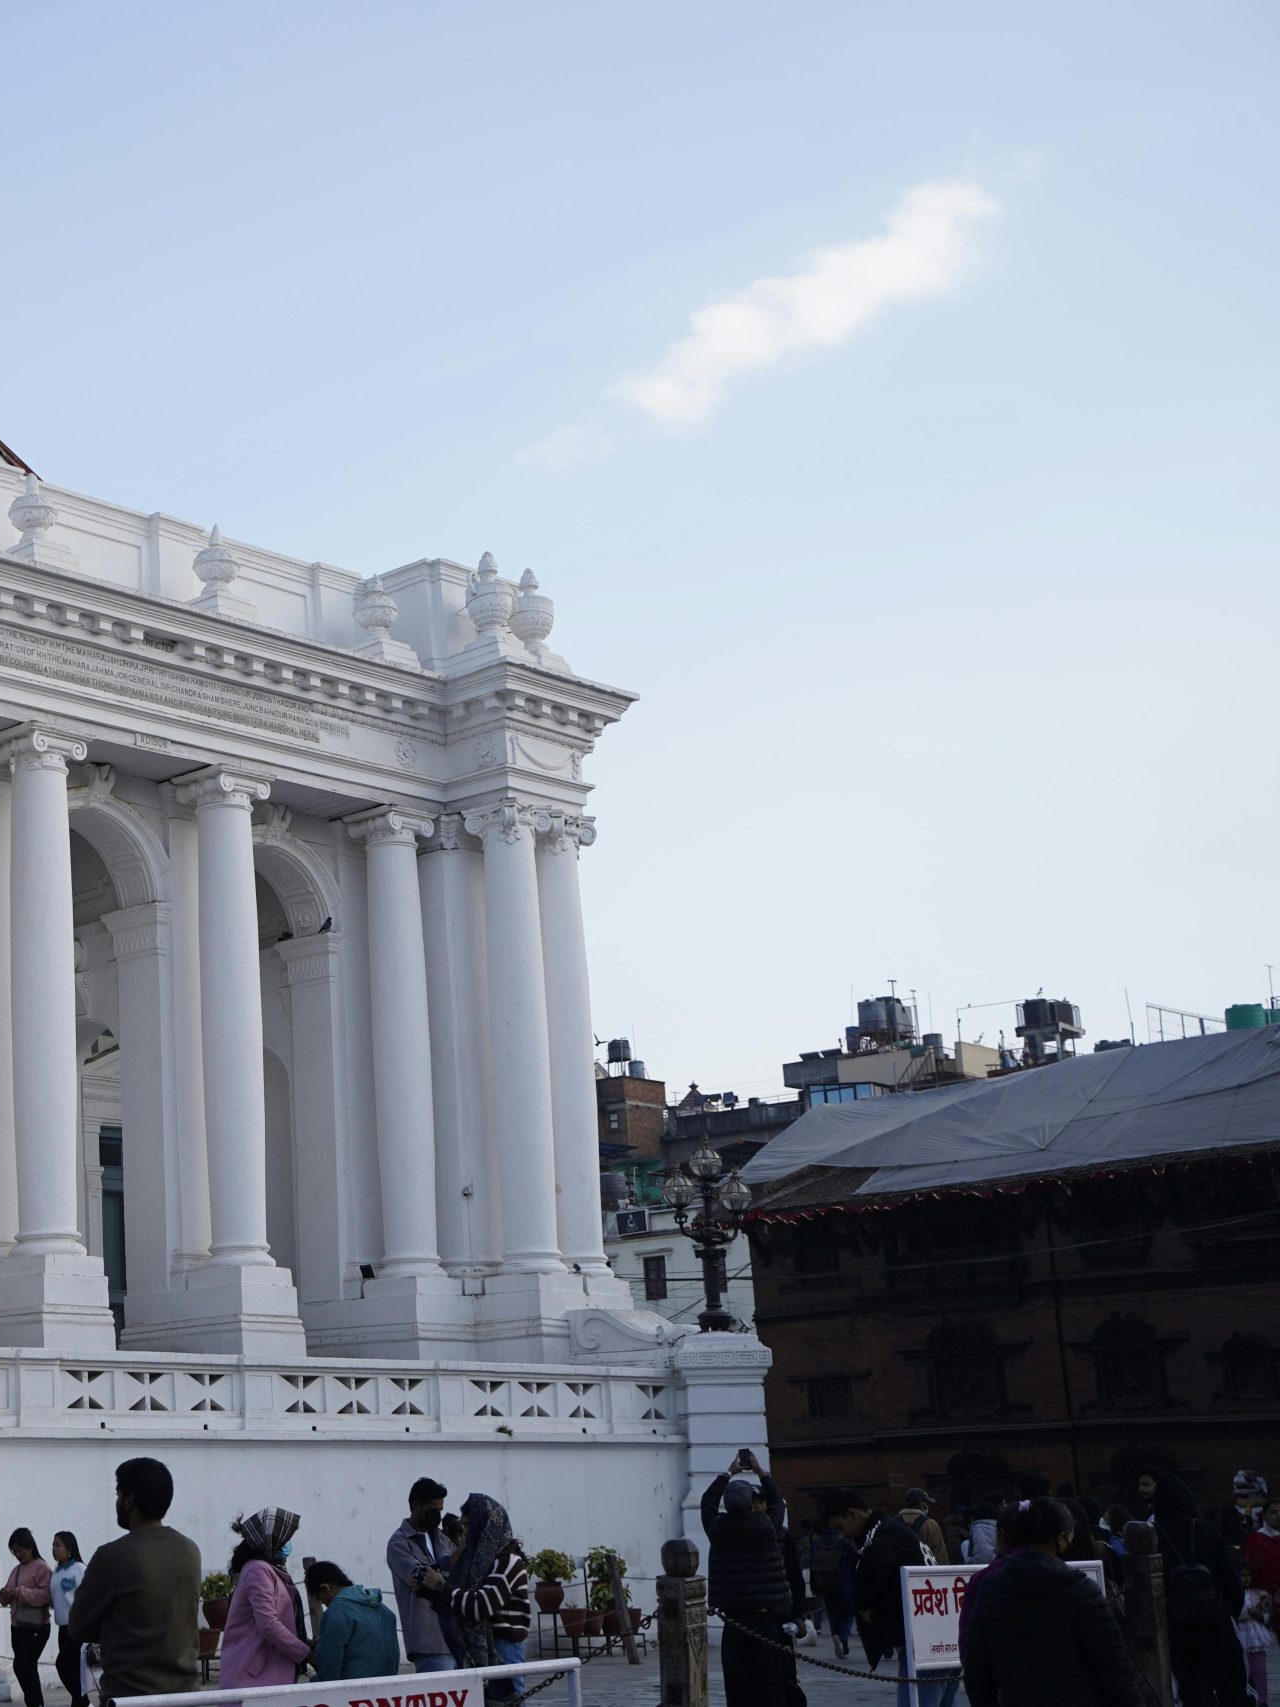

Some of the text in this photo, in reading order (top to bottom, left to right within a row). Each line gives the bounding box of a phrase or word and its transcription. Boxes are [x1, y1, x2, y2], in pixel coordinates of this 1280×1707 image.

[9, 656, 42, 673] COLONEL
[299, 727, 319, 740] NEPAL
[26, 647, 35, 657] OF
[47, 652, 61, 664] THE
[62, 656, 103, 675] MAHARAJAH
[104, 667, 127, 681] MAJOR
[128, 673, 159, 689] GENERAL
[160, 681, 170, 691] SIR
[259, 705, 287, 720] BAHADUR
[912, 1579, 948, 1617] प्रवेश
